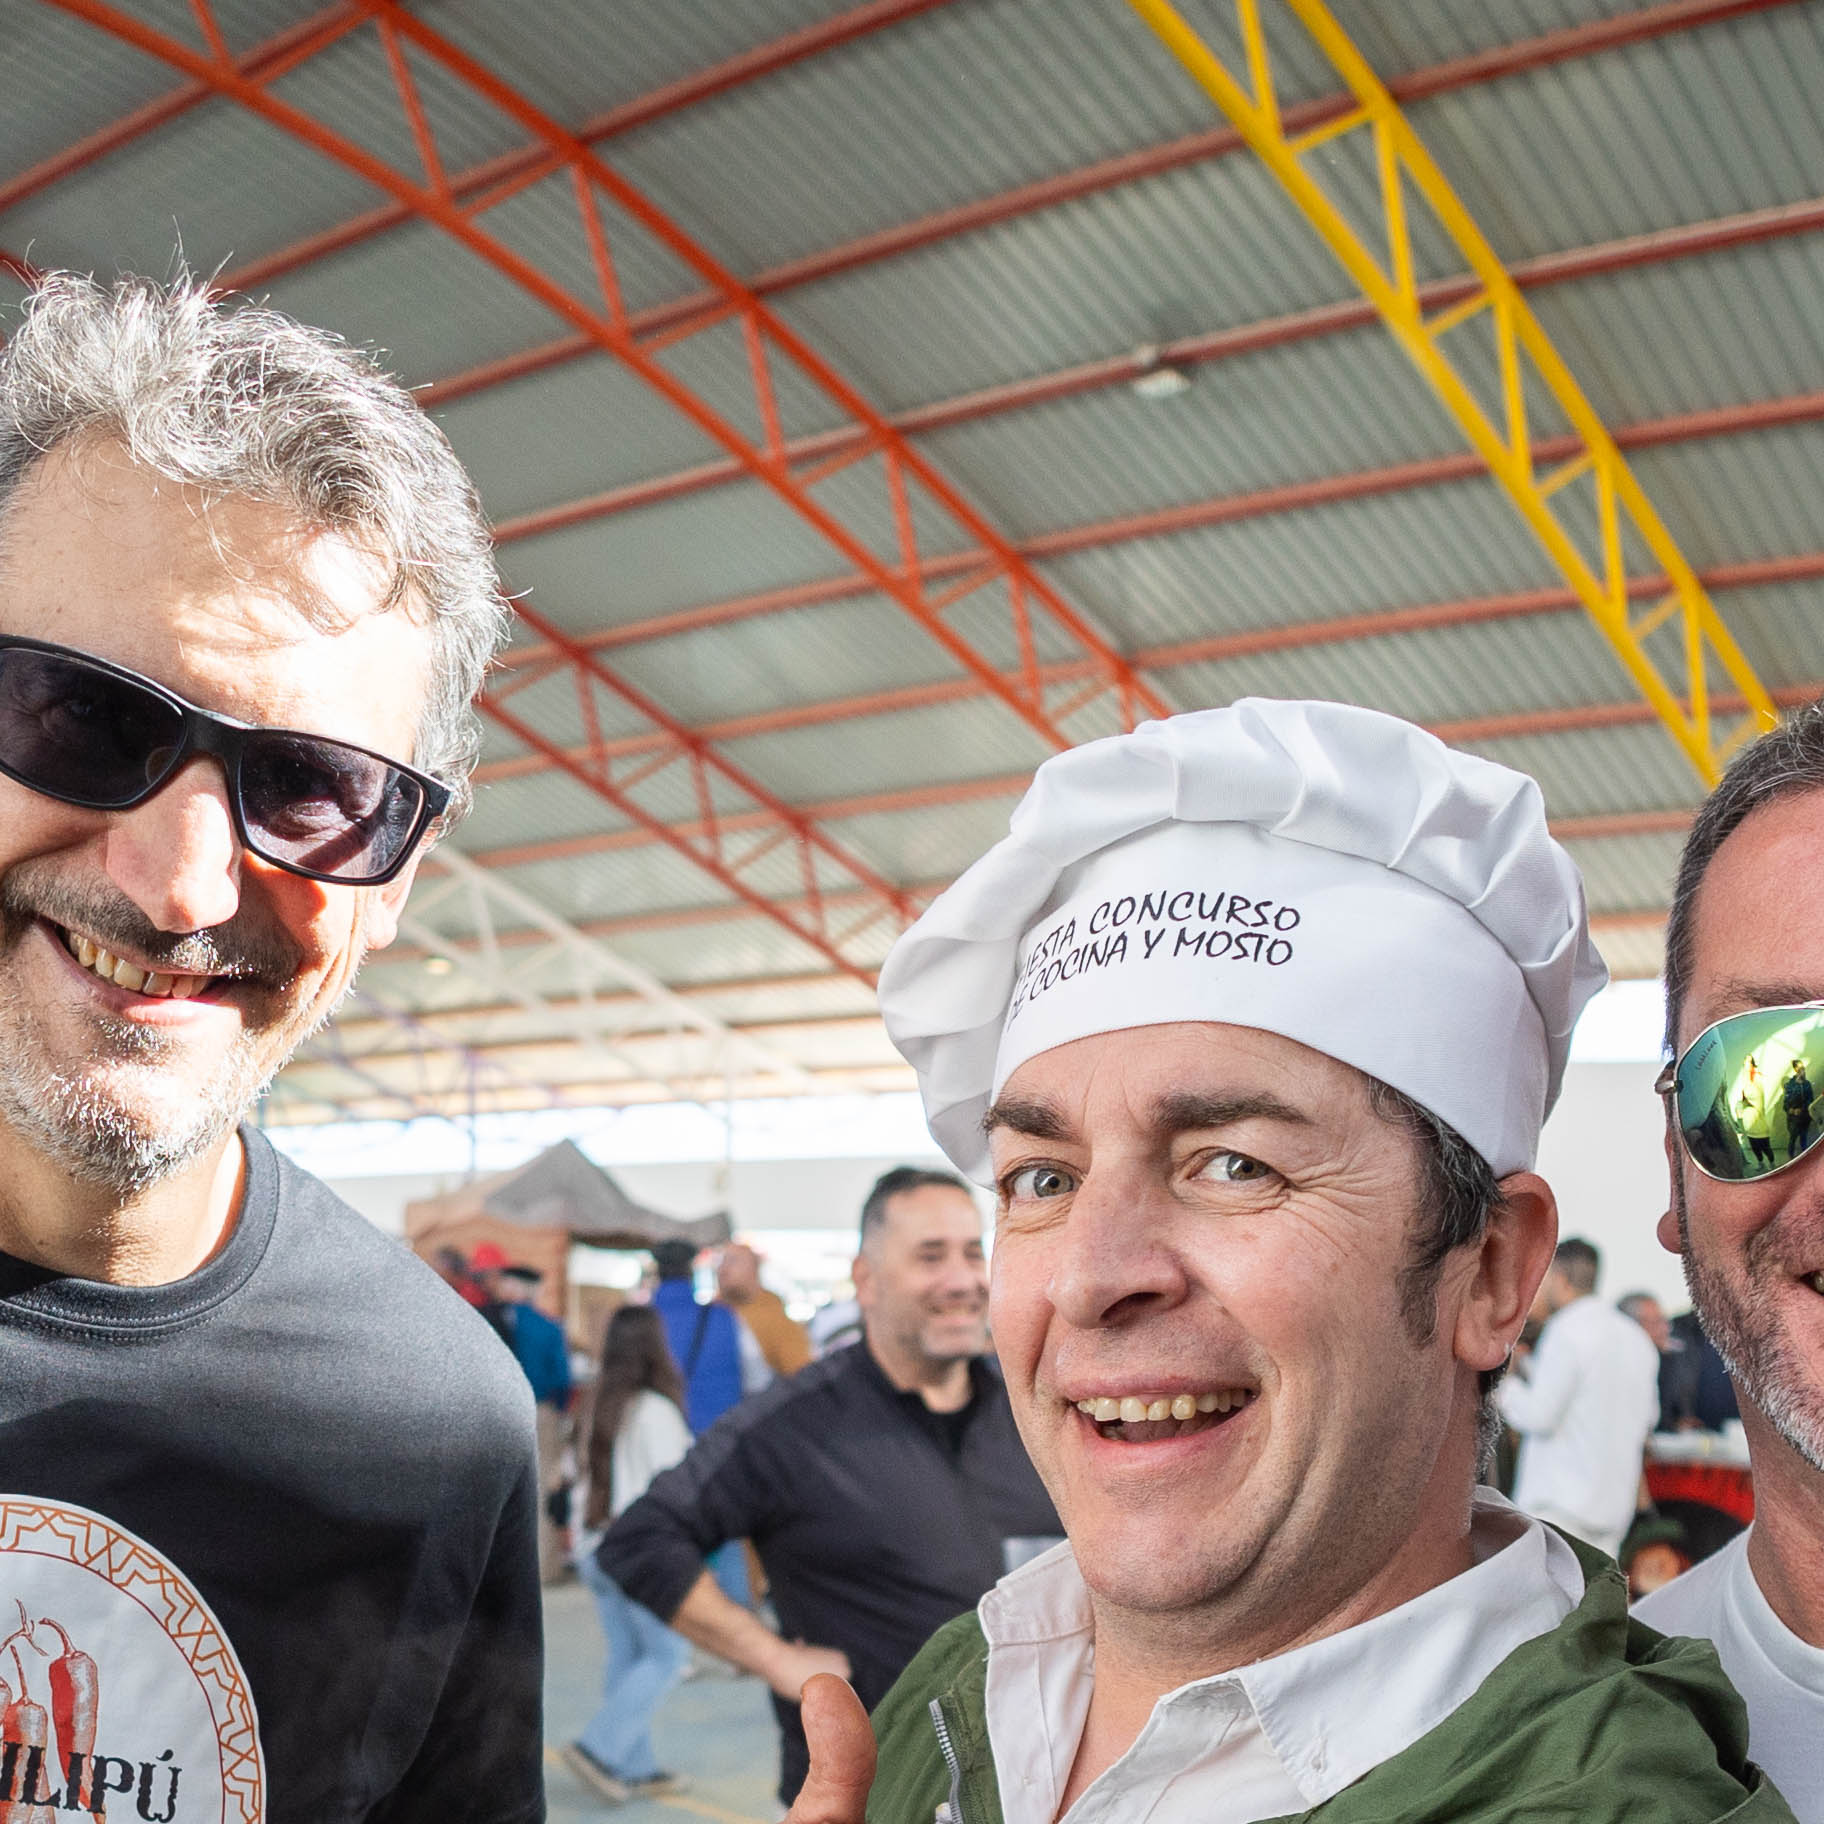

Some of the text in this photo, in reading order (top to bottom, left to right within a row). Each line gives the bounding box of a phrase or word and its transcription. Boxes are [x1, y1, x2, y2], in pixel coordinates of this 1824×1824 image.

[1089, 890, 1301, 935] CONCURSO
[1030, 931, 1128, 1000] COCINA
[1143, 930, 1164, 959] Y
[1174, 929, 1294, 966] MOSTO
